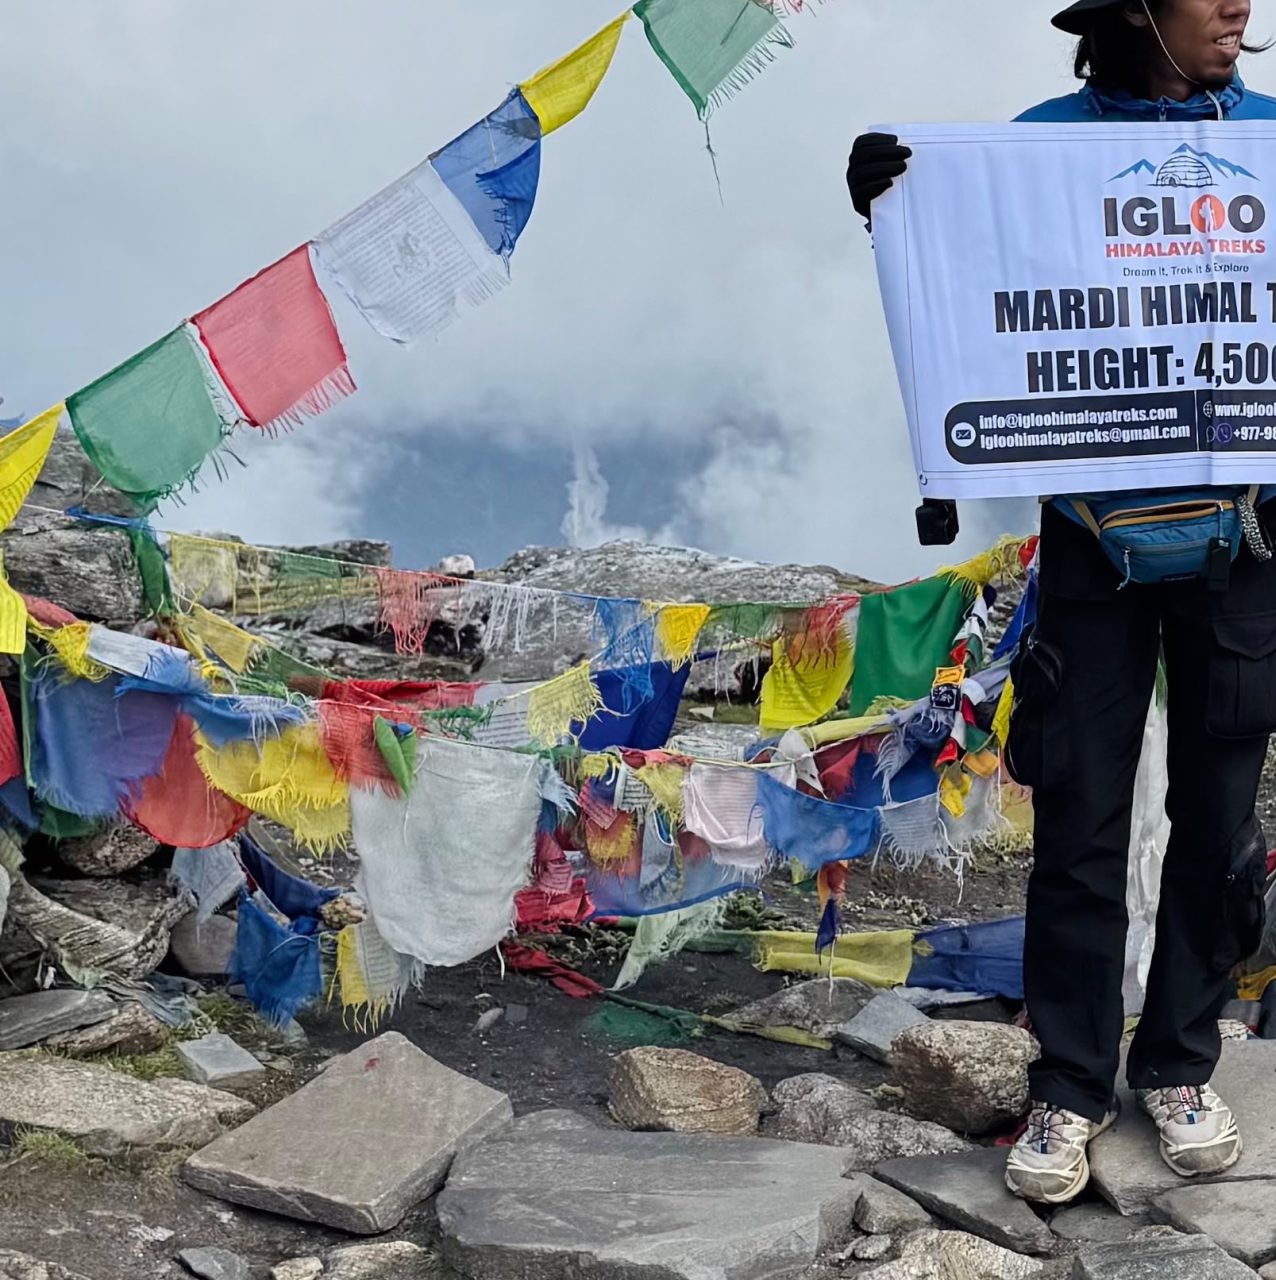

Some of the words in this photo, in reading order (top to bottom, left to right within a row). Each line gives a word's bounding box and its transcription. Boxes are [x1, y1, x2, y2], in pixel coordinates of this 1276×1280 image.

[1104, 194, 1266, 236] IGLOO
[1106, 242, 1204, 258] HIMALAYA
[1208, 239, 1265, 254] TREKS
[994, 287, 1130, 333] MARDI
[1141, 281, 1257, 327] HIMAL
[1027, 345, 1185, 393] HEIGHT:
[979, 407, 1178, 430] info@igloohimalayatreks.com
